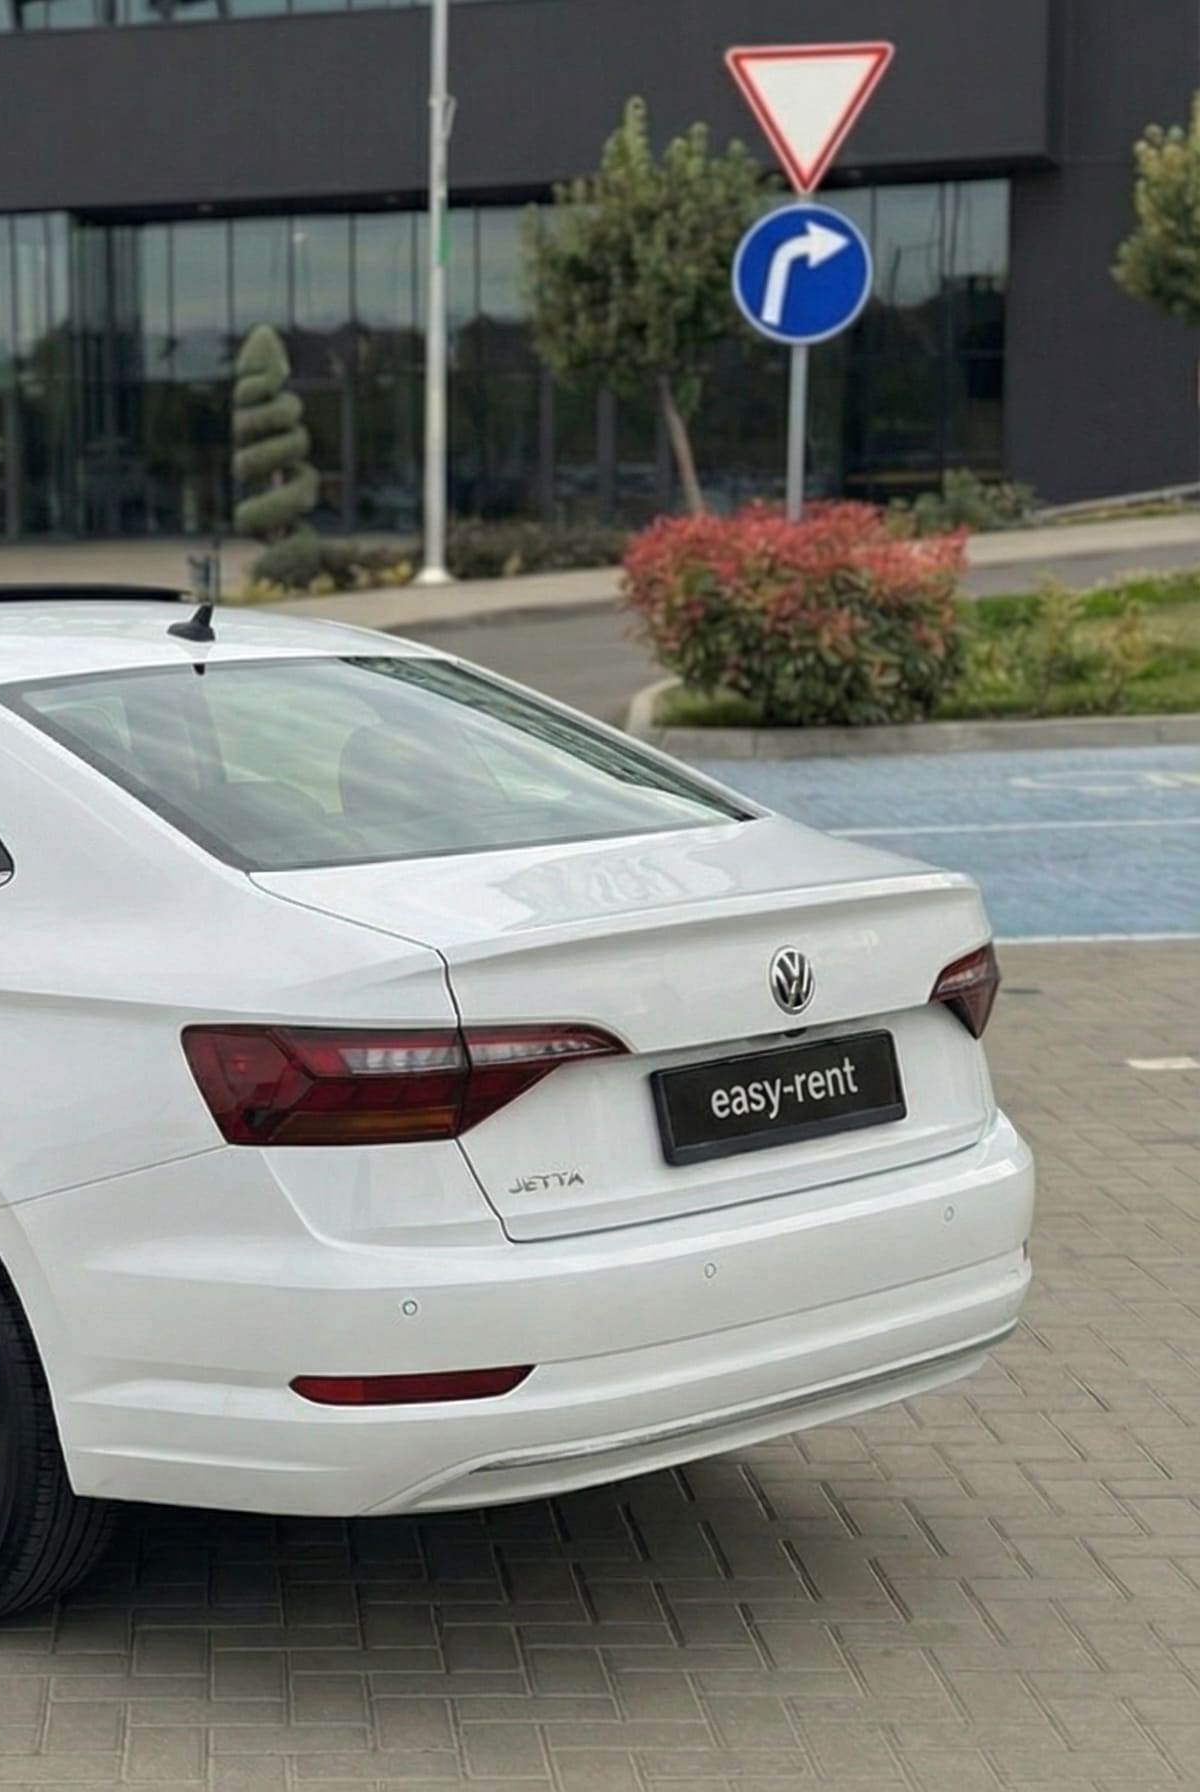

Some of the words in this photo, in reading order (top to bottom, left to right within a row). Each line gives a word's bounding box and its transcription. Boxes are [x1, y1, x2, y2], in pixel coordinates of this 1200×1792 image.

[770, 946, 814, 1014] VW
[711, 1057, 858, 1119] easy-rent
[508, 1168, 585, 1194] JETTA
